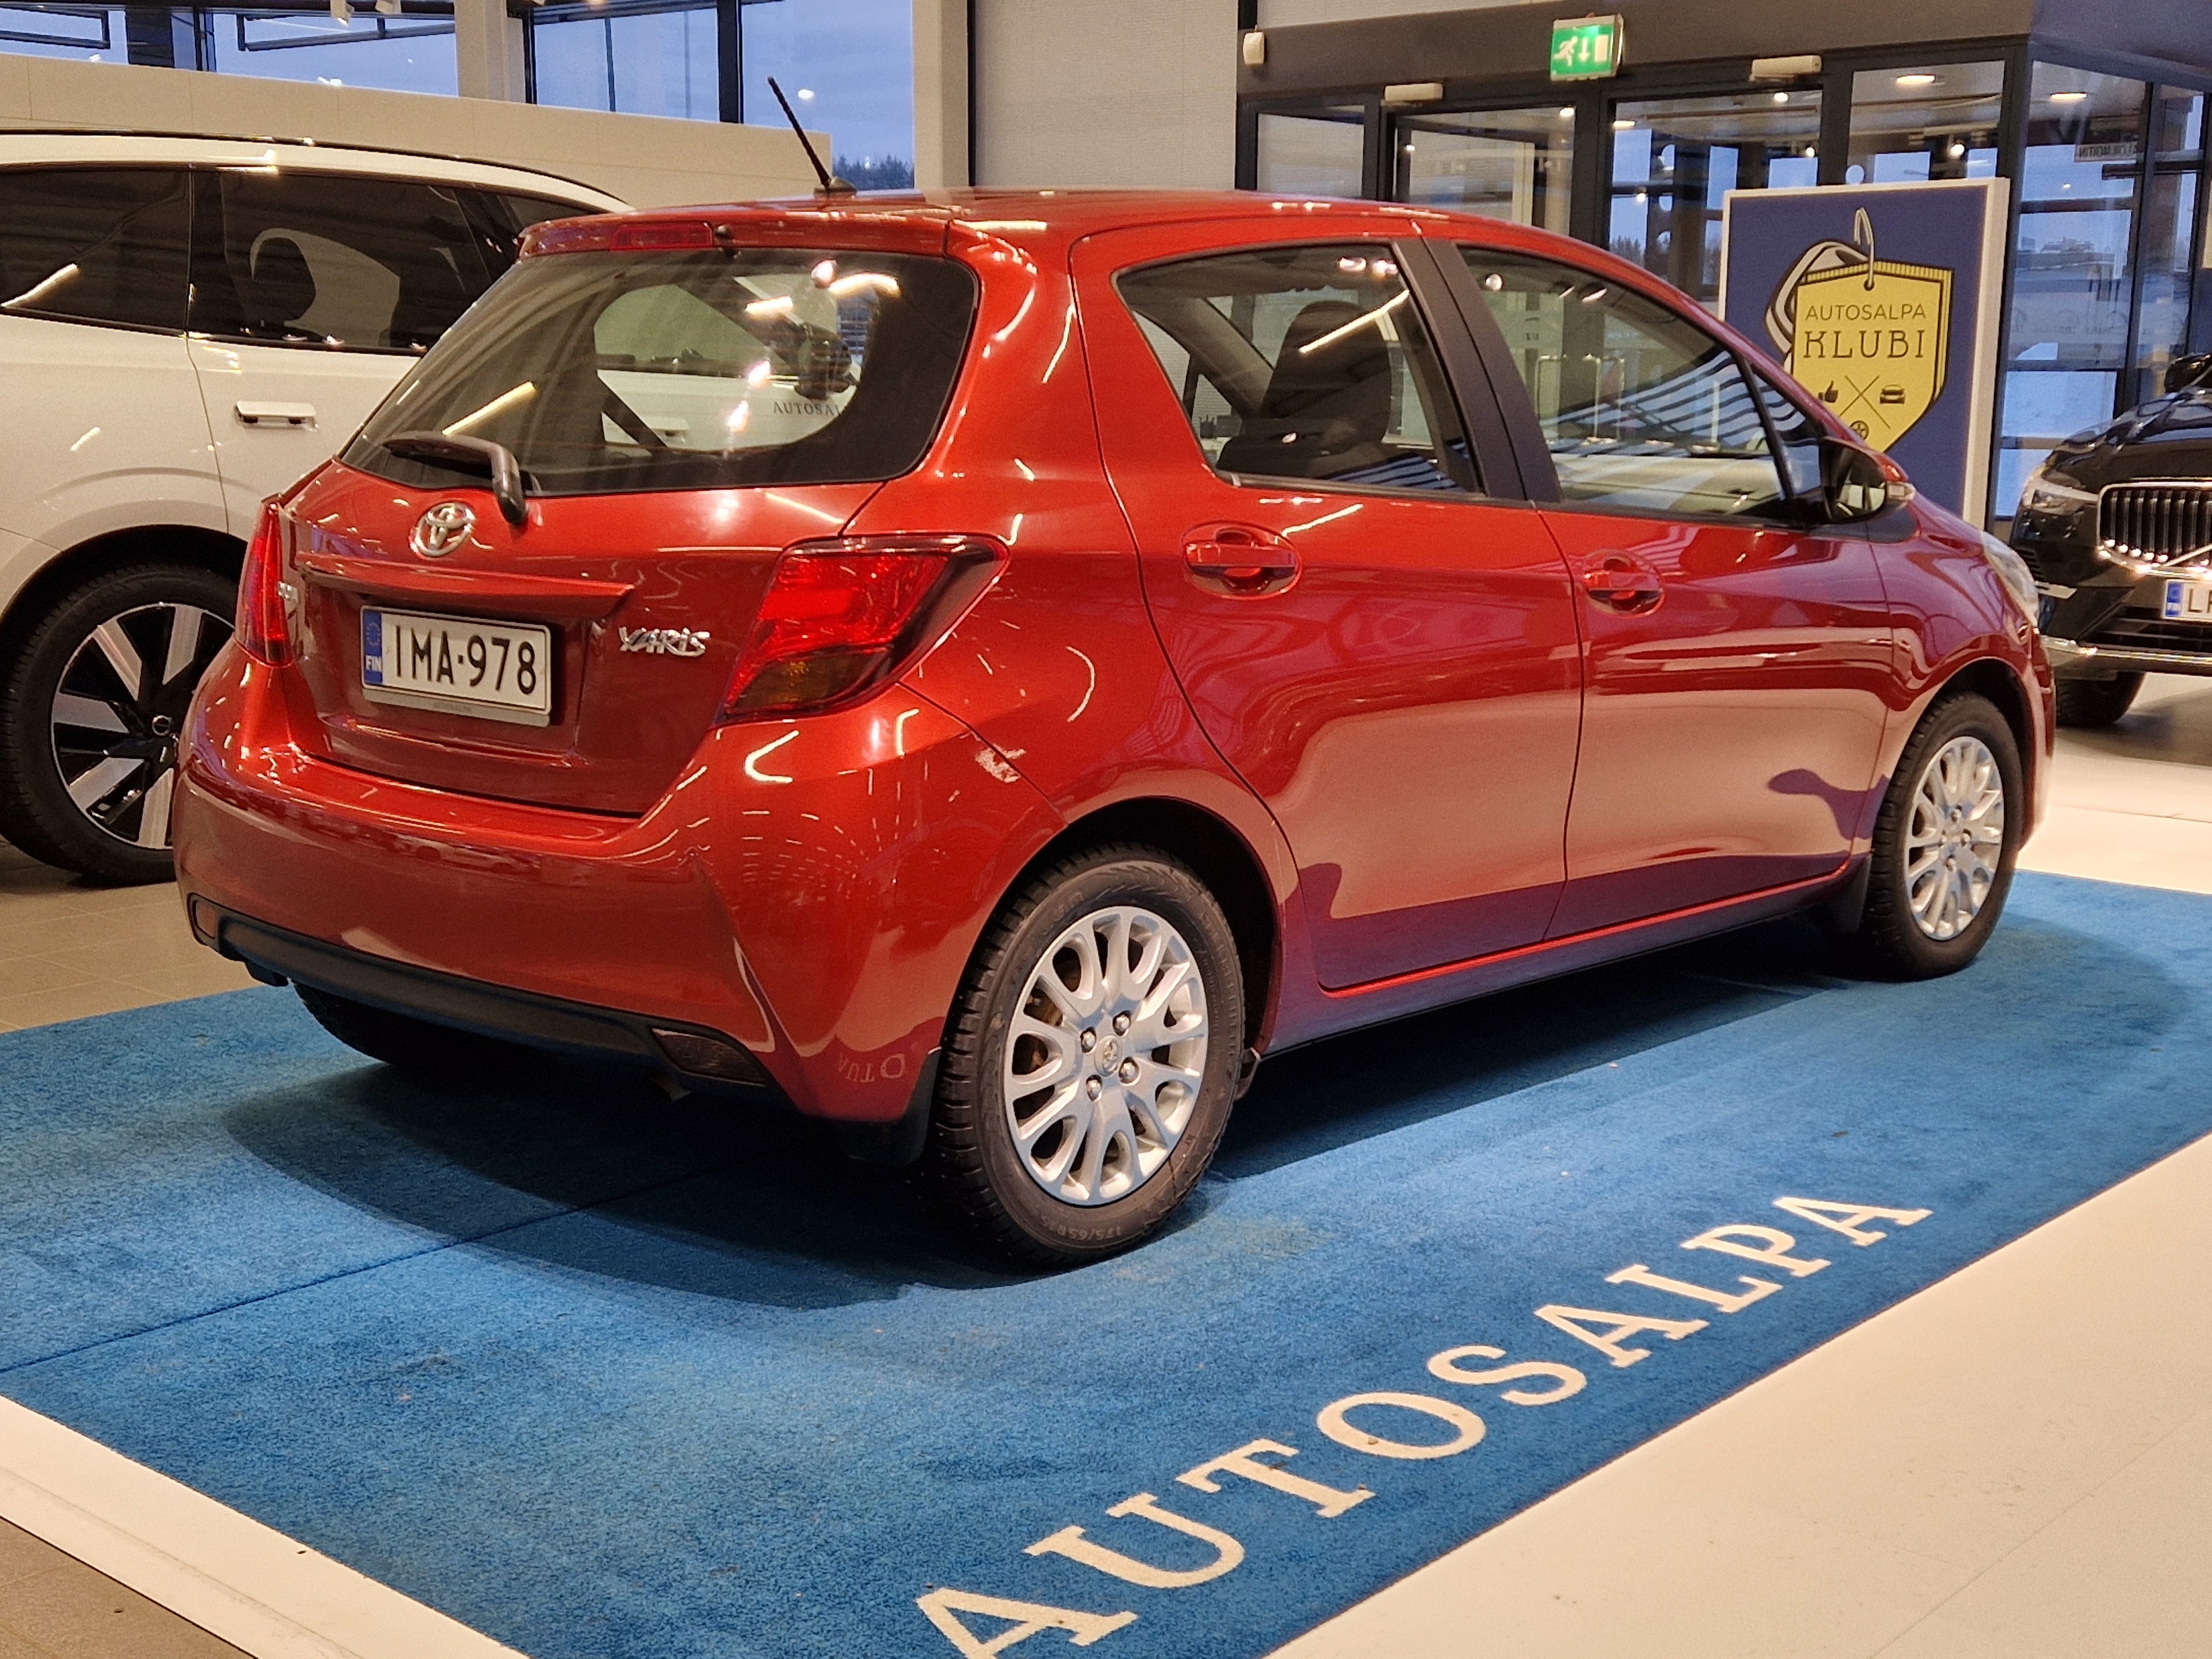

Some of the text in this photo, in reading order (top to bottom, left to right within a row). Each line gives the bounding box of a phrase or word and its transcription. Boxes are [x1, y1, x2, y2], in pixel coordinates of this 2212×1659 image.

[1805, 304, 1926, 321] AUTOSALPA
[1803, 330, 1926, 358] KLUBI
[619, 626, 711, 658] YARIS
[366, 655, 382, 672] FIN
[916, 1196, 1934, 1659] AUTOSALPA
